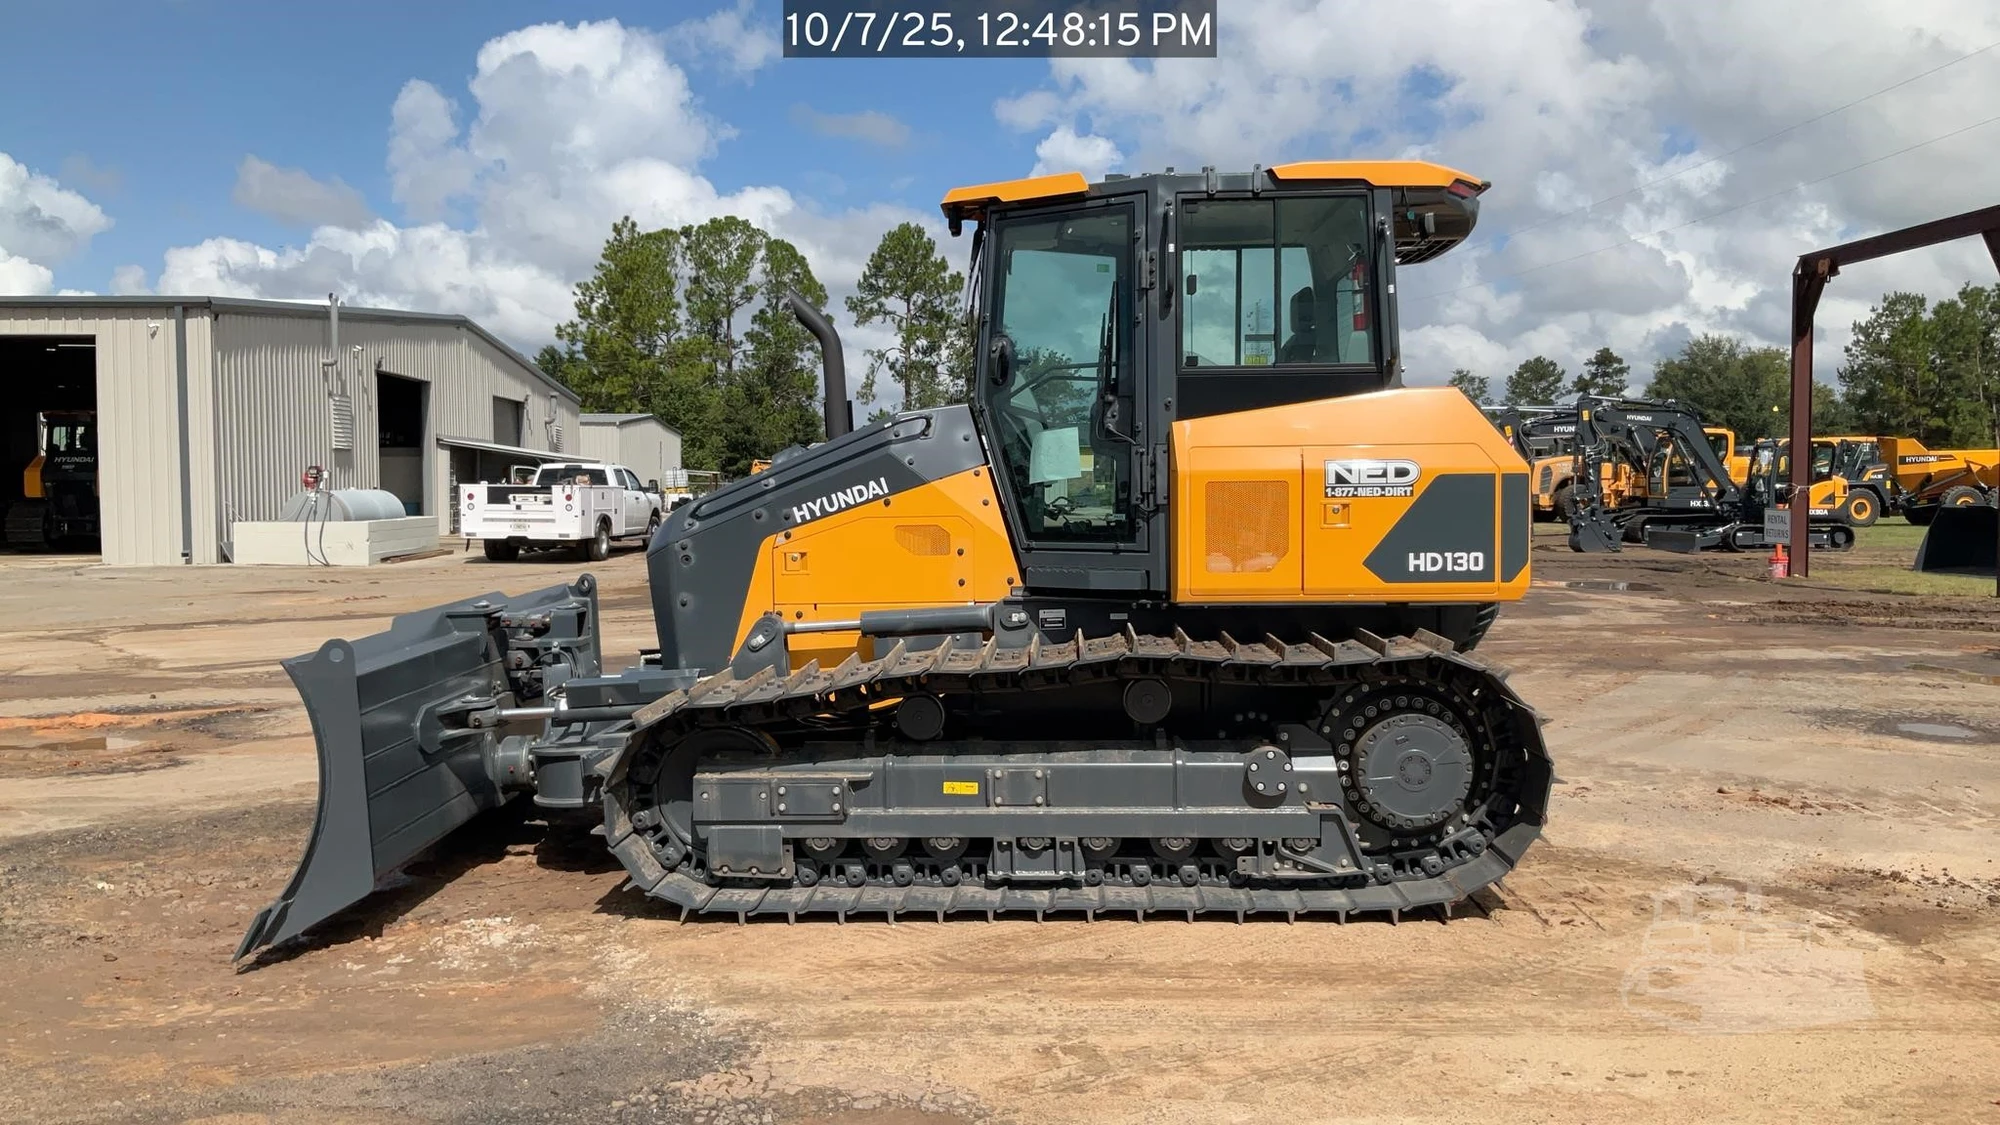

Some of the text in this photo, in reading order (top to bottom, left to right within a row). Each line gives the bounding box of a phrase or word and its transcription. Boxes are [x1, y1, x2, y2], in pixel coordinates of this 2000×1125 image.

[1327, 461, 1419, 485] NED
[1325, 486, 1413, 497] 1-877-NED-DIRT
[792, 476, 890, 524] HYUNDAI
[1767, 514, 1787, 525] RENTAL
[1766, 528, 1789, 539] RETURNS
[1408, 552, 1484, 572] HD130
